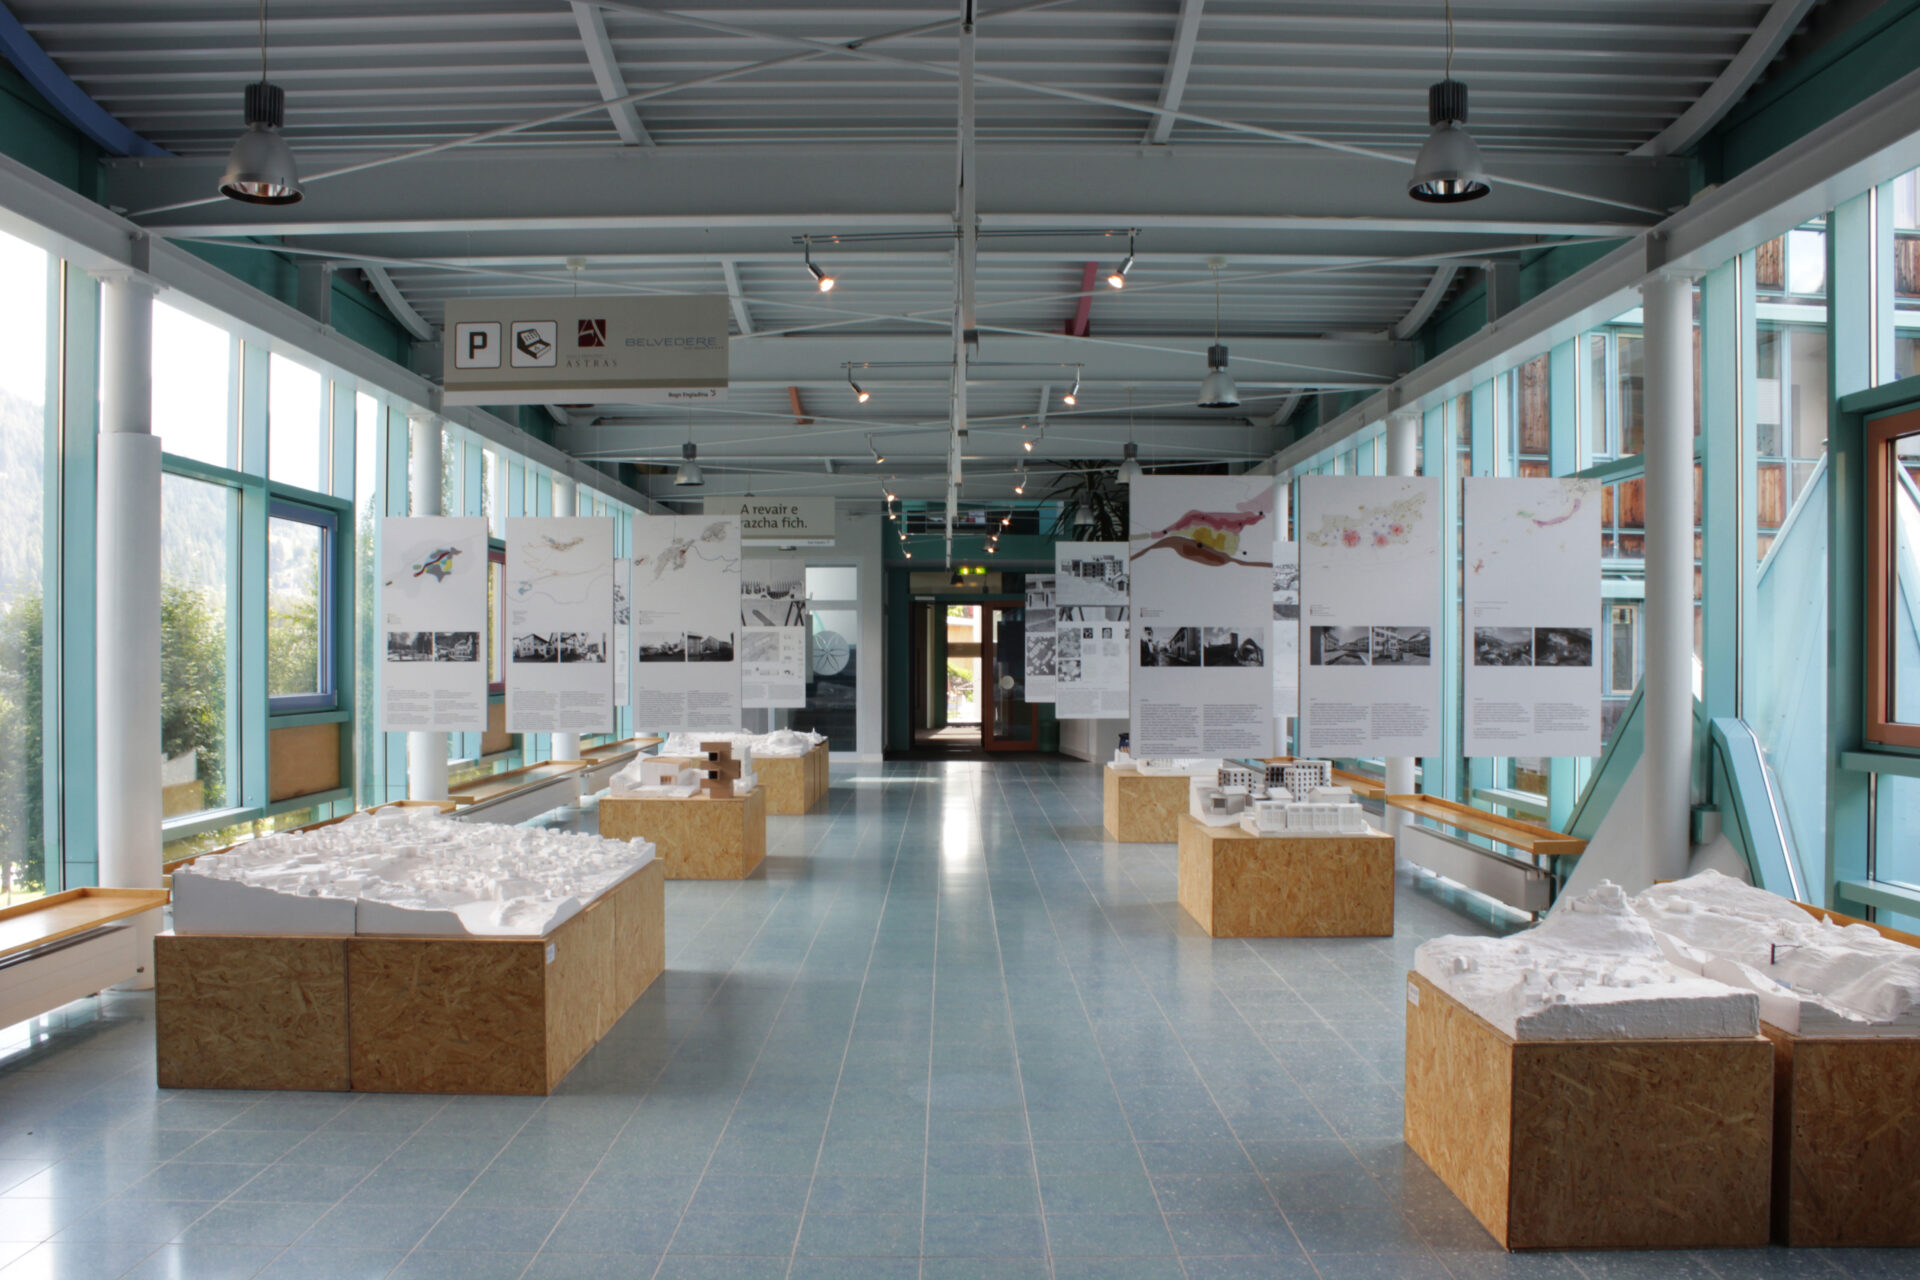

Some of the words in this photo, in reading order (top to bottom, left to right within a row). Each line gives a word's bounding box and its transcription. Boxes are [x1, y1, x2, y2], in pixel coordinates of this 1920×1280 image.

[469, 332, 487, 359] P
[625, 336, 717, 347] BELVEDERE
[566, 360, 618, 368] ASTRAS
[740, 504, 749, 514] A
[752, 504, 787, 515] revair
[791, 506, 799, 515] e
[782, 516, 808, 528] fich.
